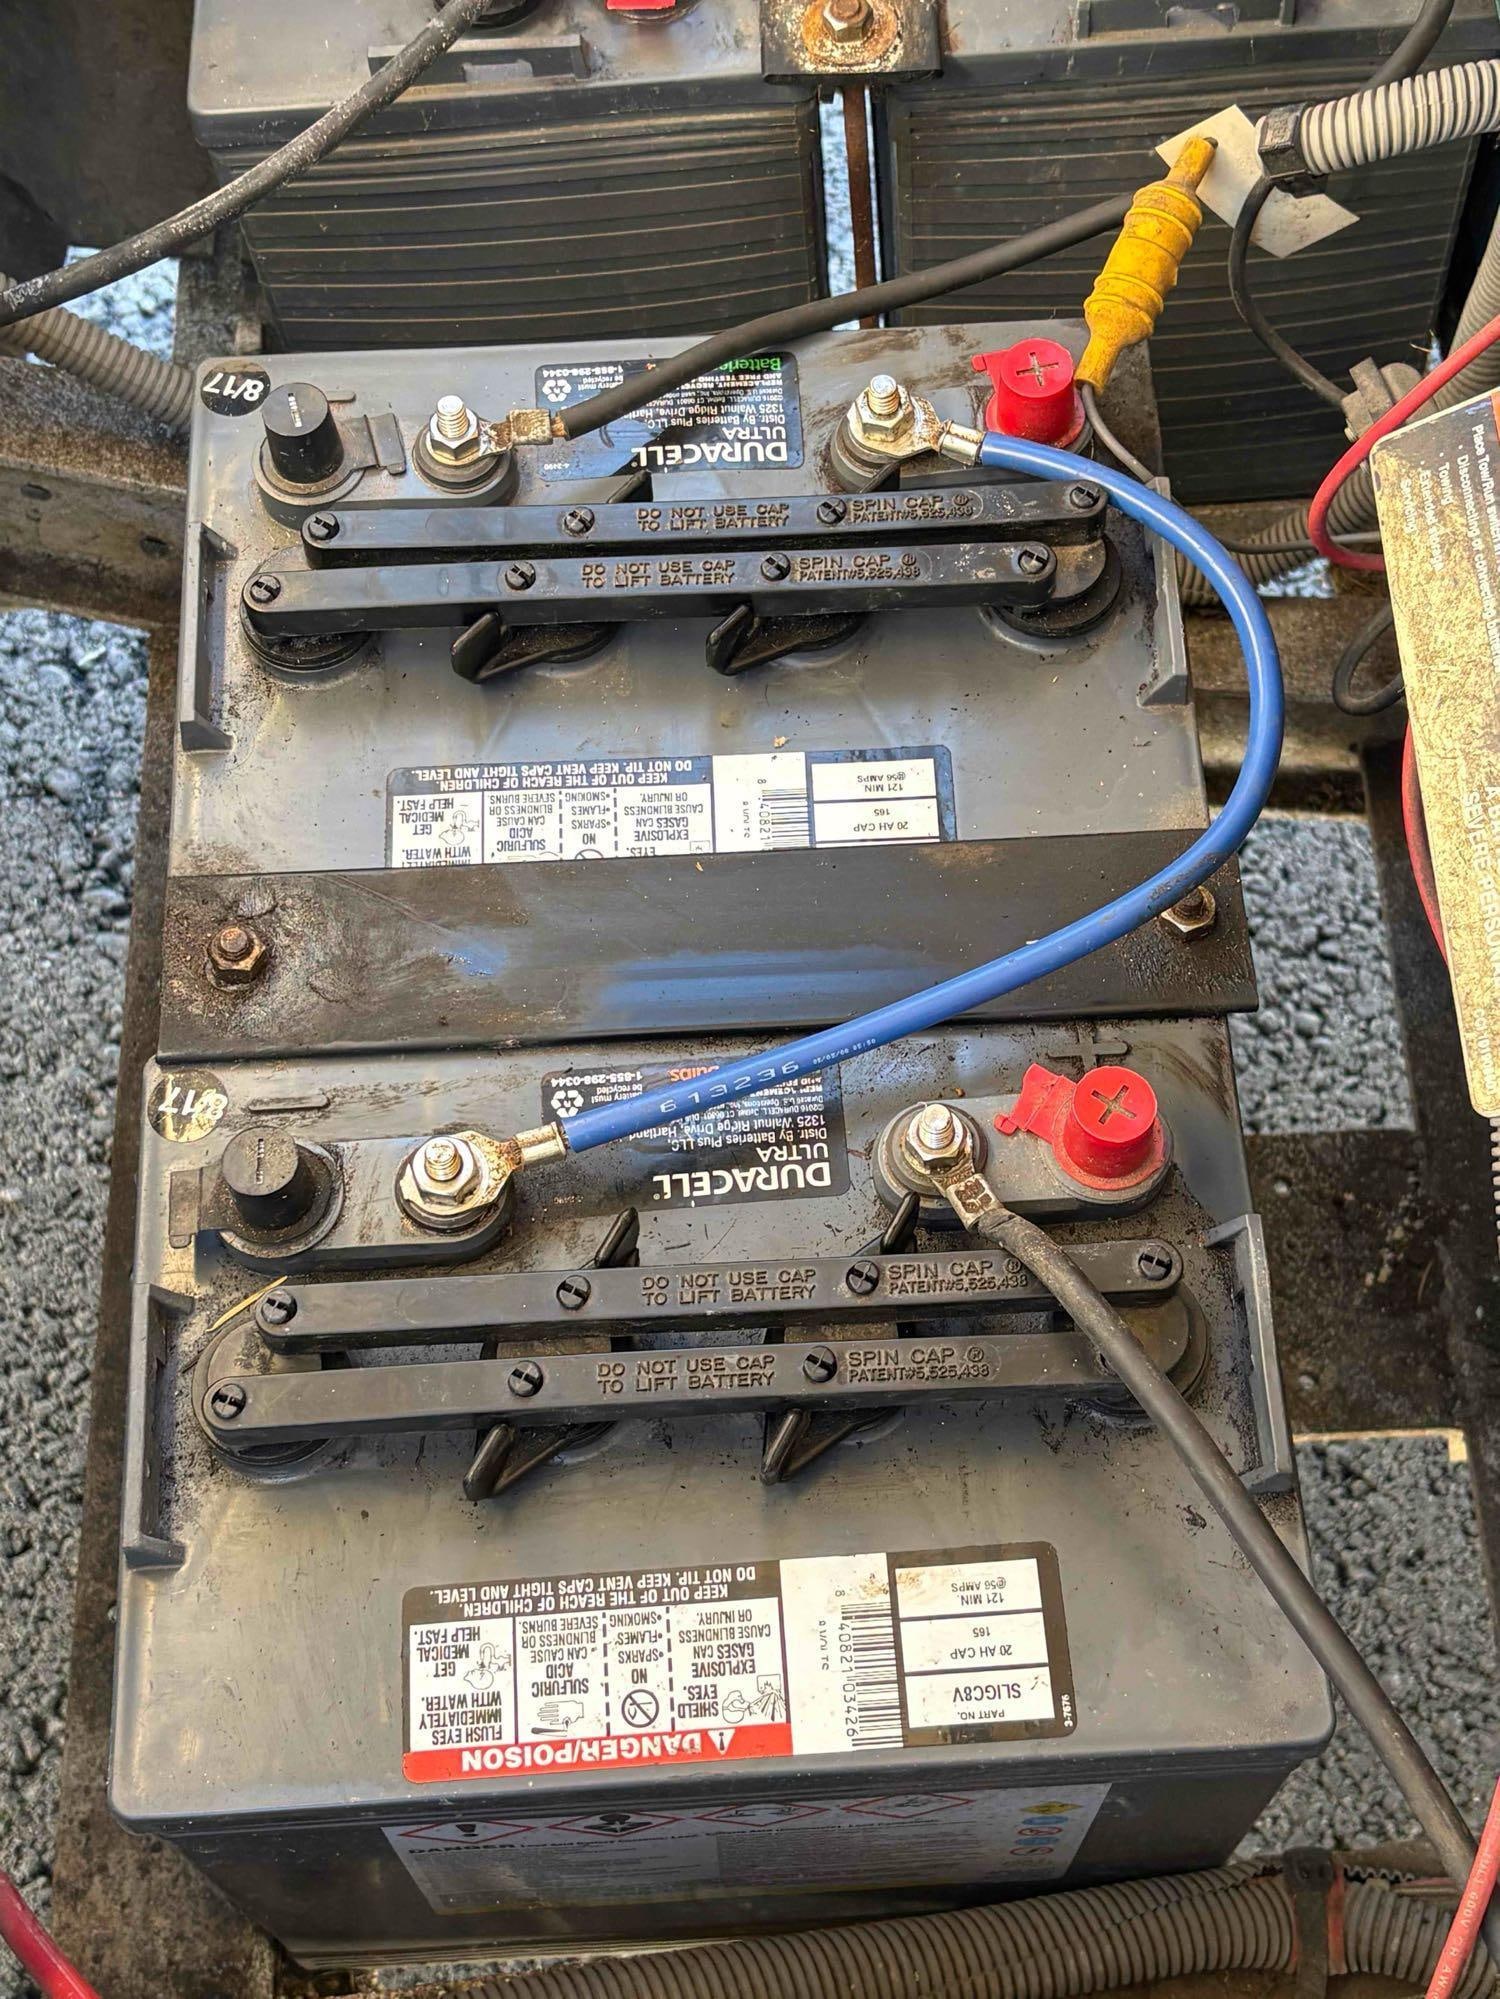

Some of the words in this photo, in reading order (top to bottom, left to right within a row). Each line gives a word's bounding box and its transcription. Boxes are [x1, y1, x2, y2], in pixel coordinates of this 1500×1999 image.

[202, 372, 265, 402] 8/17
[688, 405, 717, 416] Ridge
[720, 404, 757, 414] Walnut
[760, 403, 784, 414] 1325
[671, 417, 693, 427] Plus
[696, 415, 740, 426] Batteries
[743, 413, 756, 424] By
[760, 414, 785, 424] Distr.
[722, 426, 786, 440] ULTRA
[1470, 424, 1488, 456] Place
[1479, 455, 1496, 504] Tow/Run
[1437, 463, 1453, 504] Towing
[852, 497, 894, 512] SPIN
[905, 496, 943, 509] CAP
[637, 507, 661, 522] DO
[671, 506, 705, 520] NOT
[713, 504, 748, 518] USE
[756, 503, 789, 517] CAP
[638, 519, 660, 533] TO
[669, 517, 705, 531] LIFT
[715, 514, 789, 530] BATTERY
[582, 563, 604, 577] DO
[616, 561, 650, 576] NOT
[659, 560, 692, 573] USE
[701, 559, 734, 572] CAP
[800, 556, 842, 571] SPIN
[852, 554, 890, 568] CAP
[583, 576, 604, 589] TO
[614, 573, 650, 587] LIFT
[659, 570, 734, 586] BATTERY
[482, 766, 519, 779] TIGHT
[521, 765, 553, 778] CAPS
[555, 764, 586, 776] VENT
[588, 762, 619, 776] KEEP
[623, 762, 645, 774] TIP.
[648, 760, 672, 773] NOT
[674, 759, 692, 771] DO
[411, 768, 452, 782] LEVEL.
[454, 767, 480, 779] AND
[637, 771, 668, 784] KEEP
[754, 1116, 794, 1130] Walnut
[796, 1114, 826, 1126] 1325
[725, 1131, 776, 1145] Batteries
[779, 1128, 794, 1142] By
[796, 1127, 827, 1139] Distr.
[697, 1135, 722, 1148] Plus
[755, 1142, 829, 1162] ULTRA
[889, 1264, 938, 1279] SPIN
[949, 1260, 992, 1277] CAP
[642, 1276, 669, 1291] DO
[680, 1273, 720, 1289] NOT
[729, 1270, 766, 1286] USE
[779, 1268, 816, 1285] CAP
[642, 1291, 667, 1306] TO
[679, 1289, 719, 1305] LIFT
[732, 1285, 815, 1301] BATTERY
[849, 1351, 898, 1366] SPIN
[910, 1348, 954, 1364] CAP
[598, 1362, 624, 1378] DO
[637, 1360, 676, 1376] NOT
[687, 1358, 726, 1372] USE
[737, 1354, 774, 1370] CAP
[598, 1379, 623, 1393] TO
[636, 1375, 677, 1391] LIFT
[688, 1370, 774, 1388] BATTERY
[636, 1571, 671, 1588] KEEP
[674, 1570, 701, 1586] TIP.
[704, 1567, 733, 1583] NOT
[735, 1566, 756, 1581] DO
[512, 1580, 554, 1598] TIGHT
[557, 1576, 594, 1594] CAPS
[597, 1574, 633, 1591] VENT
[951, 1581, 981, 1592] AMPS
[984, 1576, 1007, 1590] @56
[429, 1586, 476, 1604] LEVEL.
[479, 1584, 509, 1601] AND
[608, 1590, 636, 1606] THE
[639, 1589, 658, 1604] OF
[662, 1586, 690, 1602] OUT
[694, 1583, 728, 1600] KEEP
[985, 1592, 1004, 1603] 121
[459, 1596, 533, 1618] CHILDREN.
[536, 1596, 554, 1611] OF
[557, 1592, 605, 1610] REACH
[561, 1616, 598, 1631] SEVERE
[696, 1611, 735, 1626] INJURY.
[737, 1611, 752, 1624] OR
[450, 1626, 481, 1641] HELP
[519, 1618, 558, 1634] BURNS.
[738, 1624, 771, 1639] CAUSE
[973, 1626, 991, 1637] 165
[413, 1628, 446, 1645] FAST.
[521, 1634, 536, 1648] OR
[539, 1629, 596, 1646] BLINDNESS
[678, 1626, 735, 1642] BLINDNESS
[417, 1644, 470, 1661] MEDICAL
[530, 1648, 564, 1663] CAUSE
[567, 1647, 587, 1661] CAN
[693, 1645, 713, 1659] CAN
[717, 1643, 755, 1658] GASES
[950, 1647, 976, 1659] CAP
[979, 1646, 997, 1657] AH
[999, 1645, 1012, 1655] 20
[434, 1661, 456, 1677] GET
[546, 1663, 574, 1680] ACID
[631, 1669, 648, 1683] NO
[691, 1659, 756, 1678] EXPLOSIVE
[531, 1679, 589, 1697] SULFURIC
[683, 1683, 717, 1700] EYES.
[953, 1683, 1021, 1702] SLIGC8V
[420, 1694, 468, 1710] WATER.
[471, 1690, 502, 1706] WITH
[677, 1701, 719, 1719] SHIELD
[958, 1711, 975, 1720] NO.
[978, 1709, 1005, 1718] PART
[419, 1707, 502, 1729] IMMEDIATELY
[432, 1728, 462, 1745] EYES
[465, 1724, 502, 1742] FLUSH
[461, 1732, 701, 1771] DANGER/POISON
